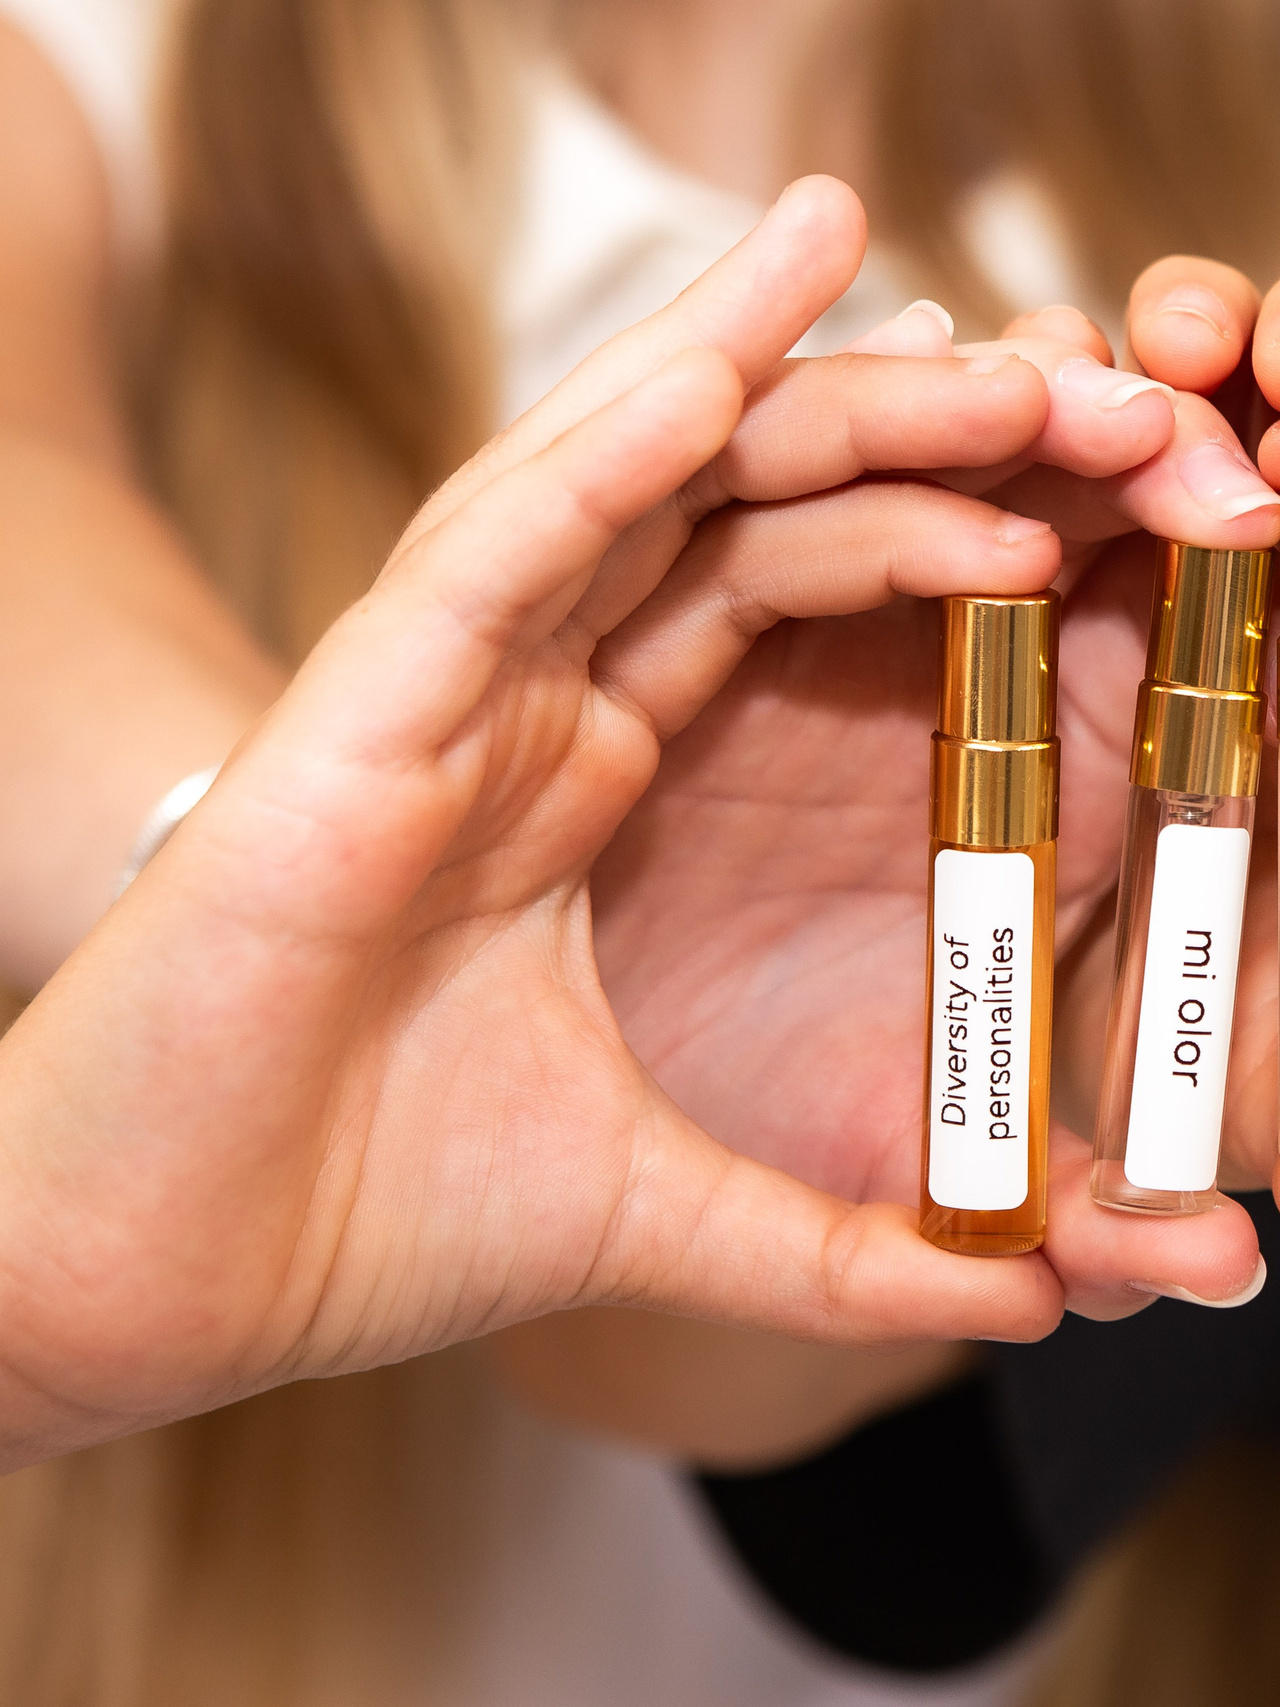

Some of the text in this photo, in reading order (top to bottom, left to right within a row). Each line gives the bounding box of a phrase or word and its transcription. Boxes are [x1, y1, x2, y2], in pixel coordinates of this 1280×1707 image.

[939, 932, 978, 1127] Diversity of
[981, 926, 1019, 1141] personalities
[1171, 928, 1218, 1089] mi olor
